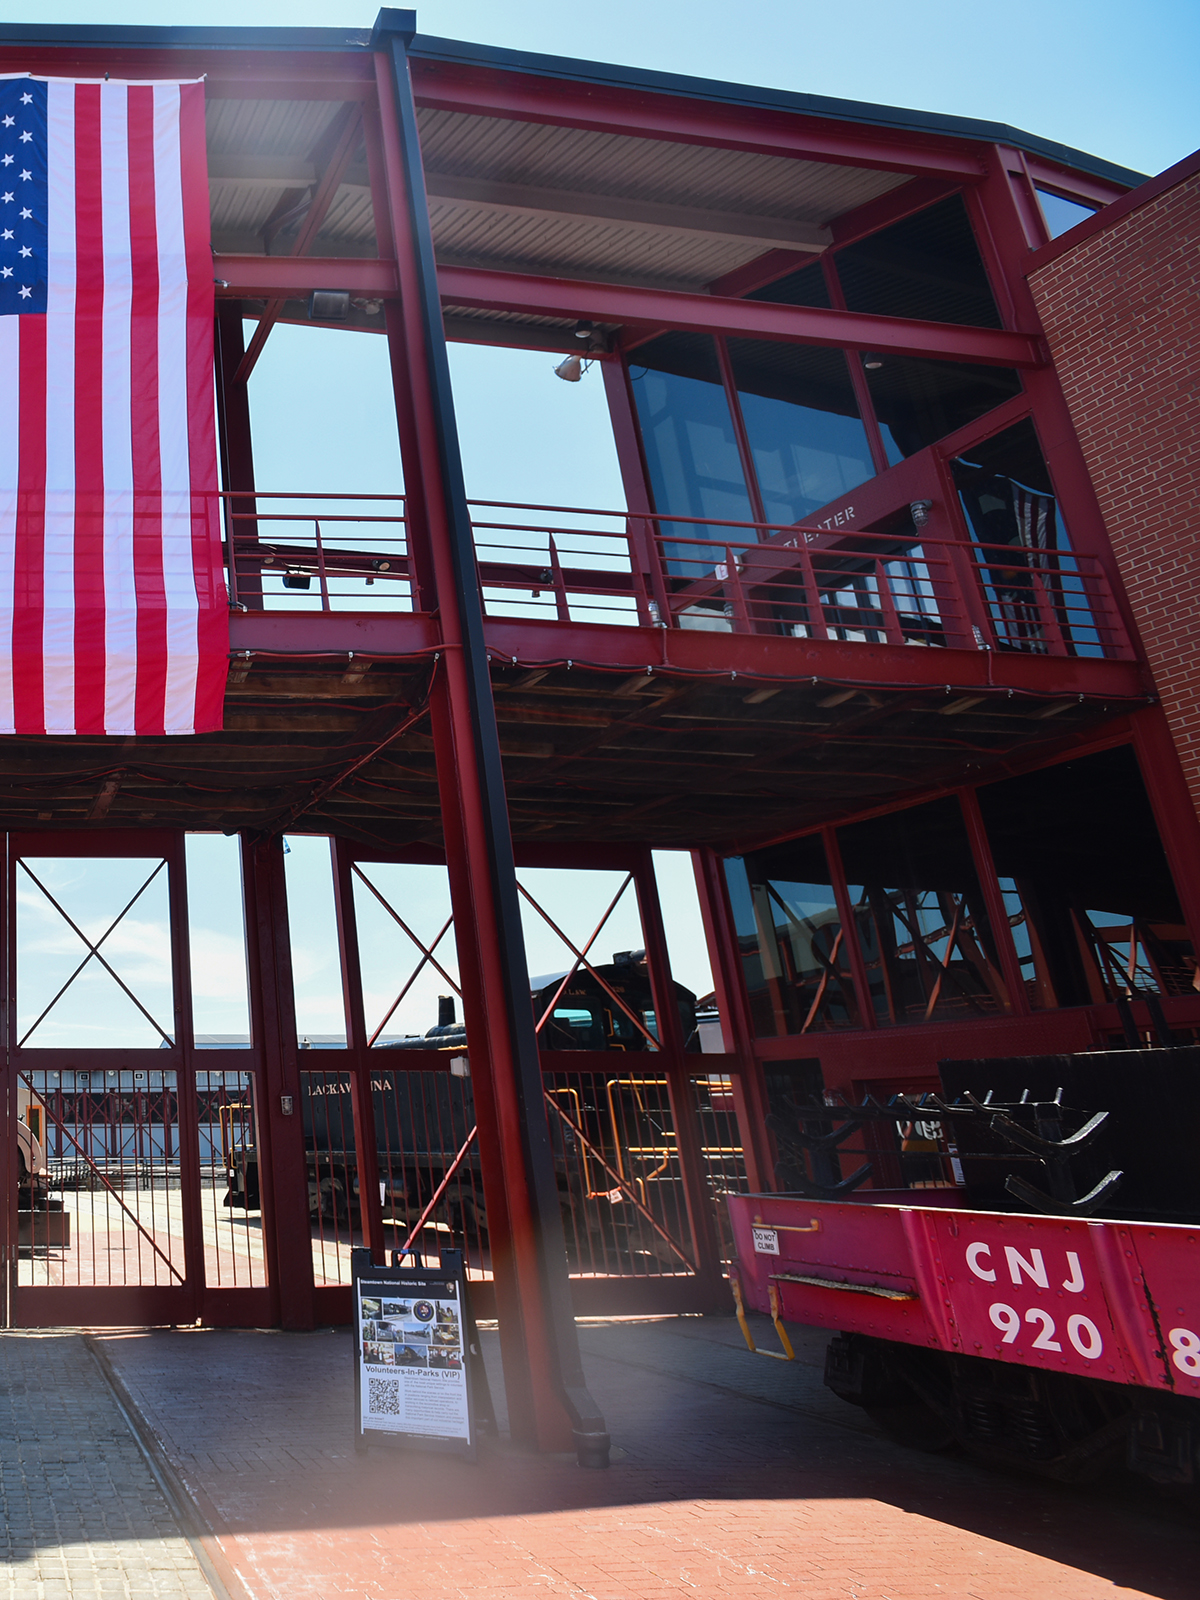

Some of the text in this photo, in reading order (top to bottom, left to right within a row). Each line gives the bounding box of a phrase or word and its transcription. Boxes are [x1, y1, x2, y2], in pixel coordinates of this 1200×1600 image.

[755, 1232, 775, 1242] DO NOT
[758, 1242, 775, 1251] CLIMB
[965, 1241, 1085, 1293] CNJ
[988, 1302, 1103, 1360] 920
[365, 1365, 461, 1380] Volunteers-In-Parks (VIP)
